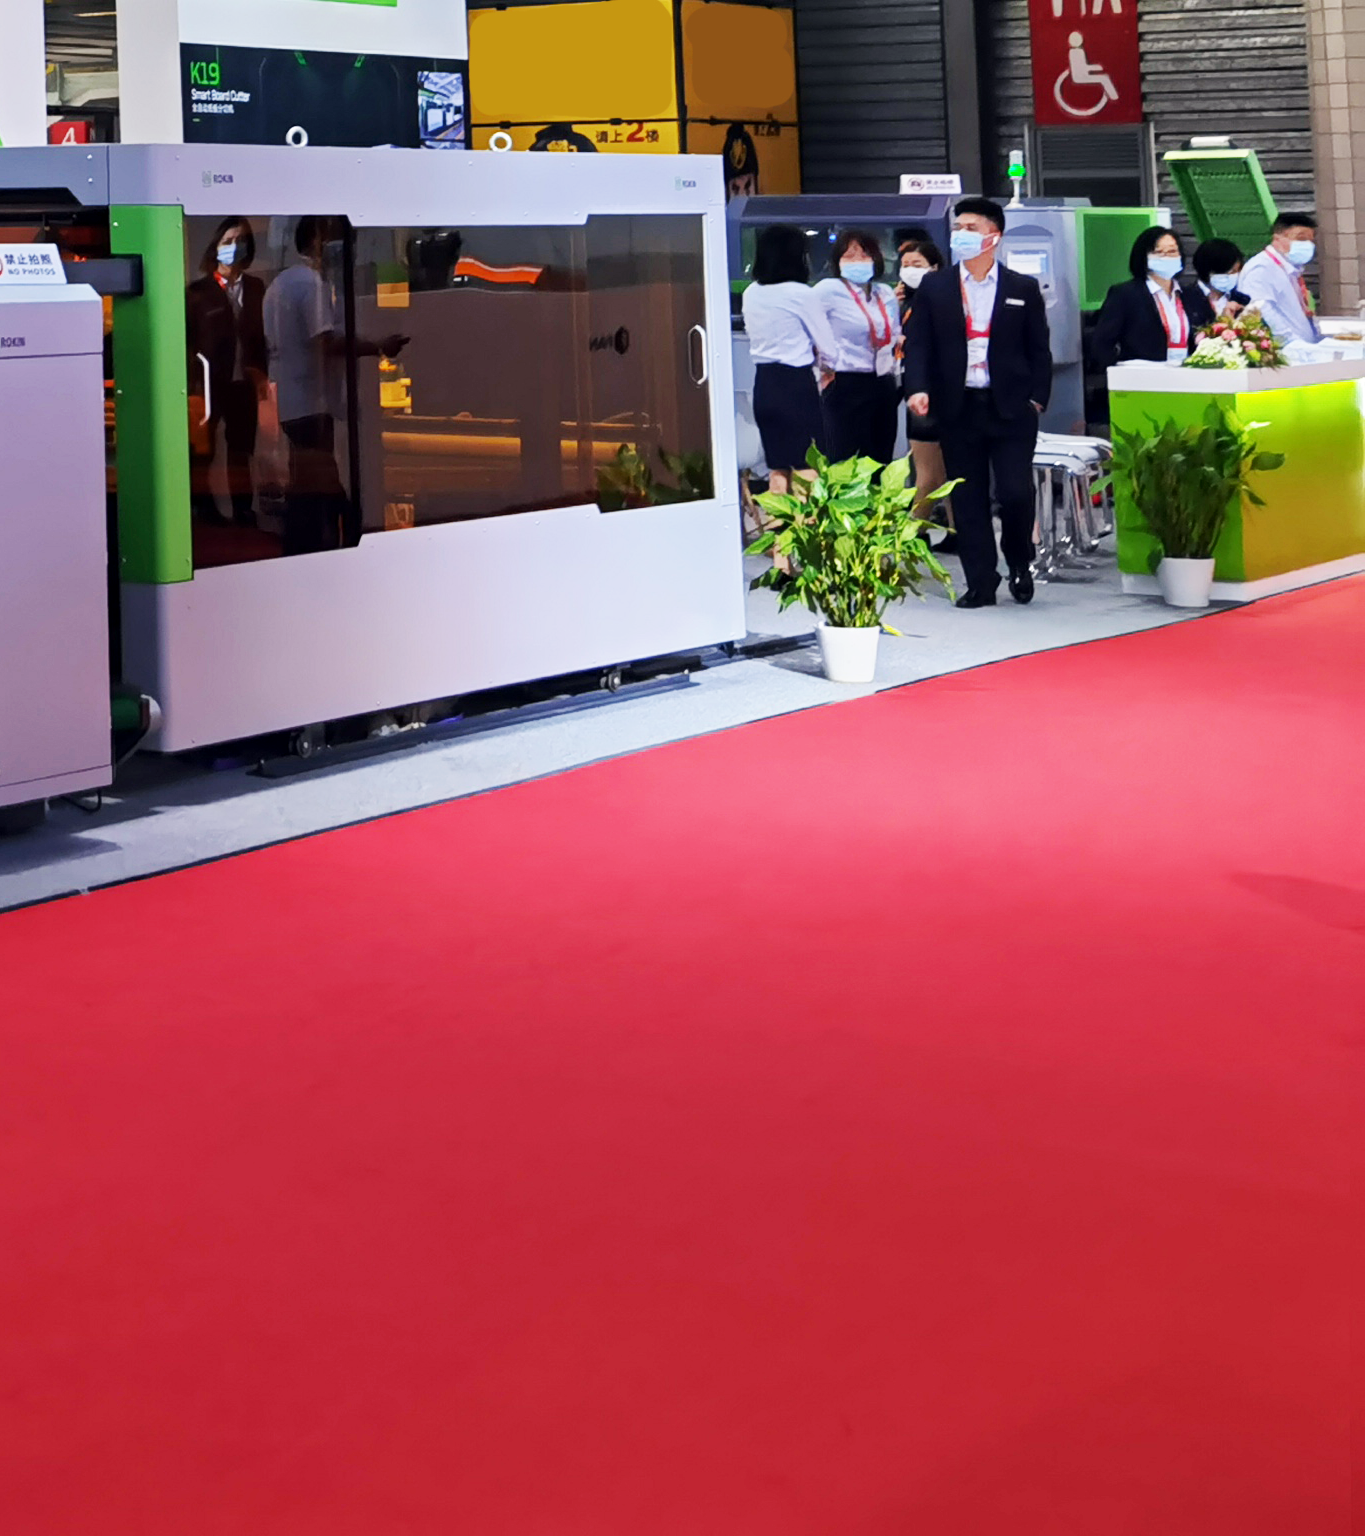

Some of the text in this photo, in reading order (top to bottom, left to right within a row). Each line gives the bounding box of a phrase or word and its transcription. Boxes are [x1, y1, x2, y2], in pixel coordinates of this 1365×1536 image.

[190, 61, 220, 85] K19
[191, 88, 211, 101] Smart
[4, 253, 53, 266] 禁止拍照
[22, 267, 57, 276] PHOTOS
